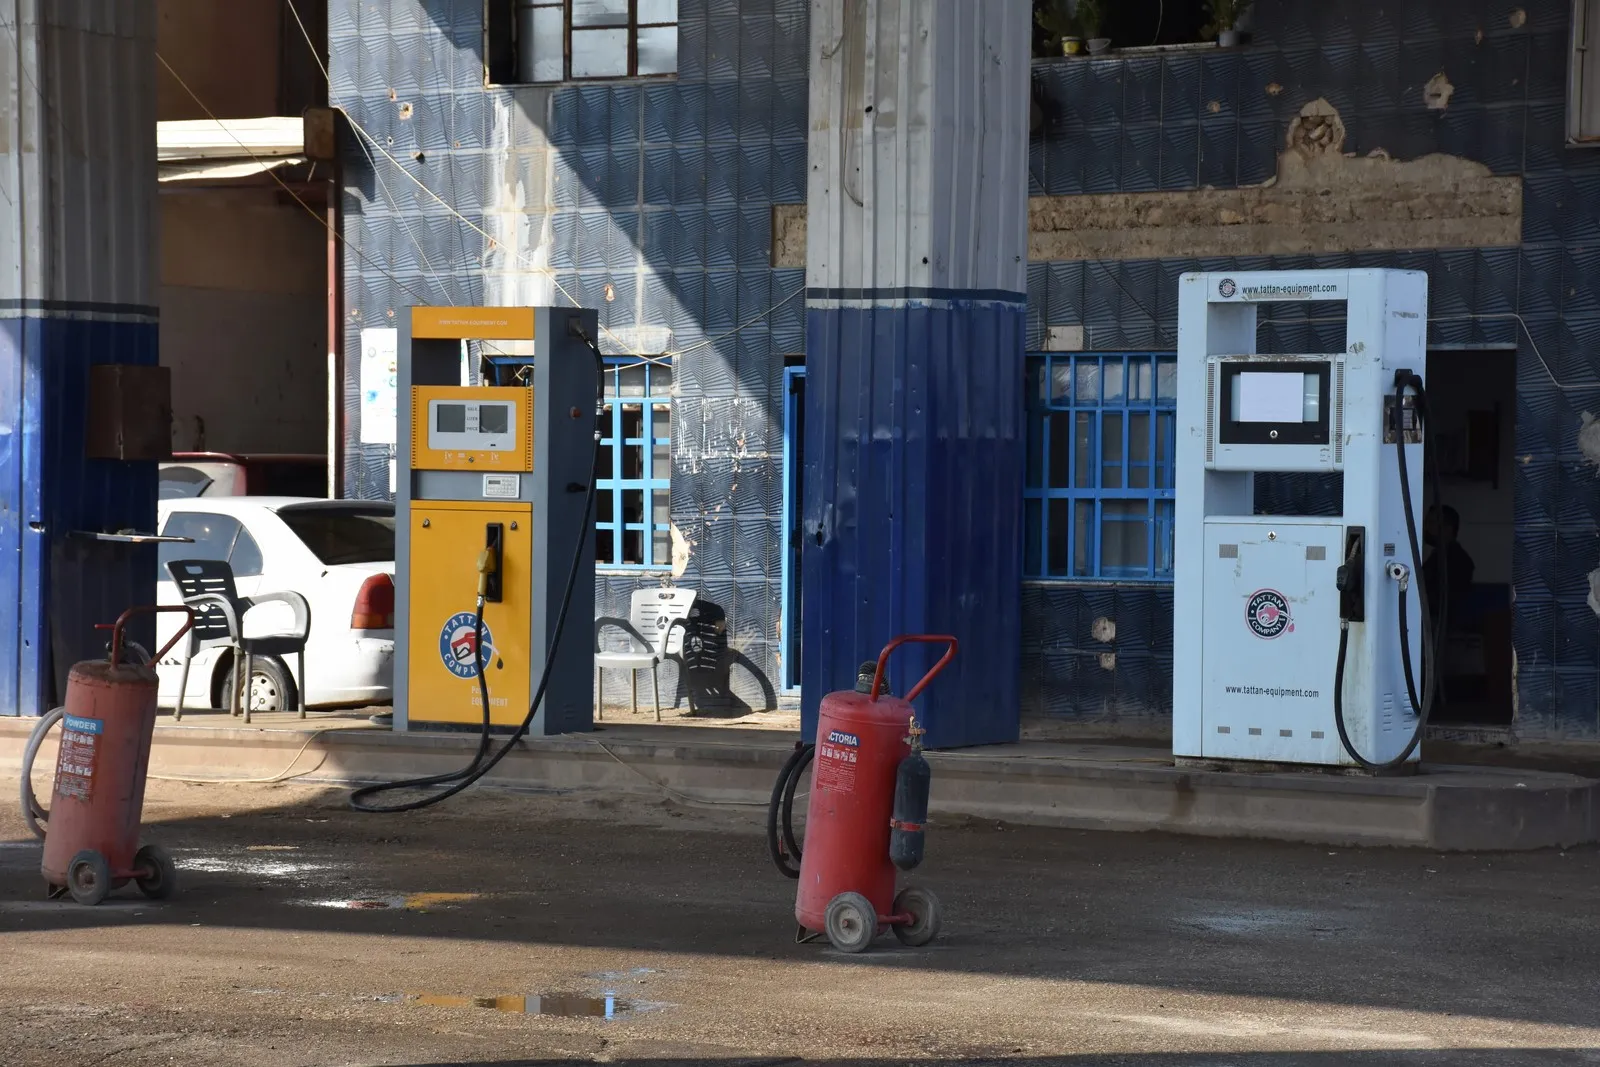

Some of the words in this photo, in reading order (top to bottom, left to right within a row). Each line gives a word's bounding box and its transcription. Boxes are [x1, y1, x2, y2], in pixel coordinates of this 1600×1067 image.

[1242, 284, 1337, 294] www.tattan-equipment.com
[1251, 594, 1284, 608] TATTAN
[444, 615, 488, 636] TATTN
[1252, 620, 1282, 634] COMPANY
[444, 653, 487, 676] COMPAY
[1225, 685, 1320, 698] www.tattan-equipment.com
